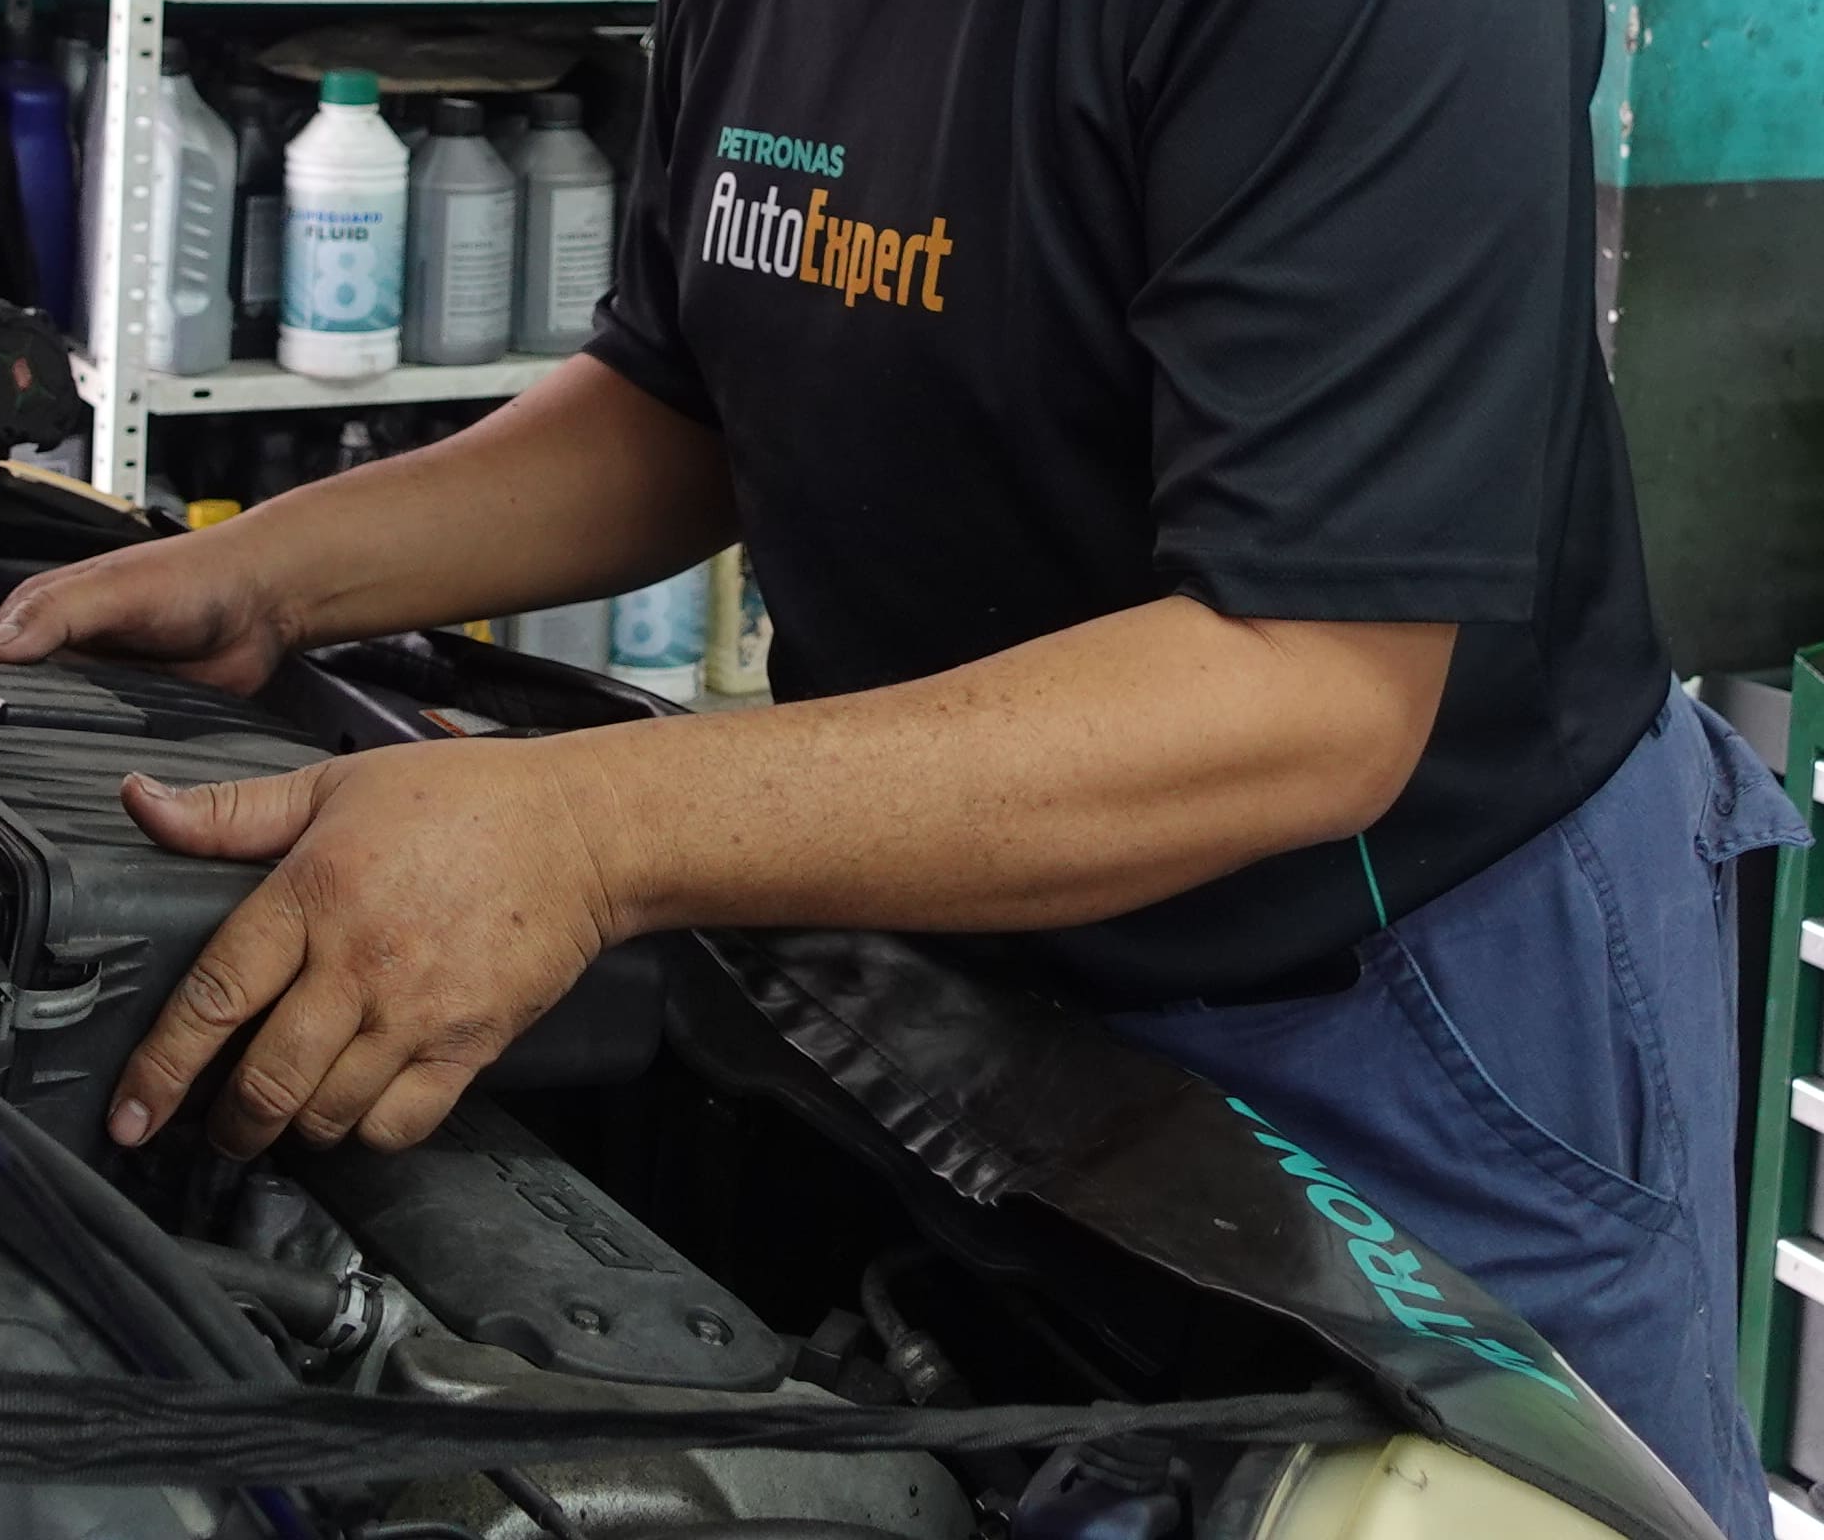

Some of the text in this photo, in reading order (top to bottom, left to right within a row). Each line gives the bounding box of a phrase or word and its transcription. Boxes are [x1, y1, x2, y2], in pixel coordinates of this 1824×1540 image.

[717, 126, 845, 179] PETRONAS
[315, 241, 378, 321] 8
[702, 171, 953, 312] AutoExpert
